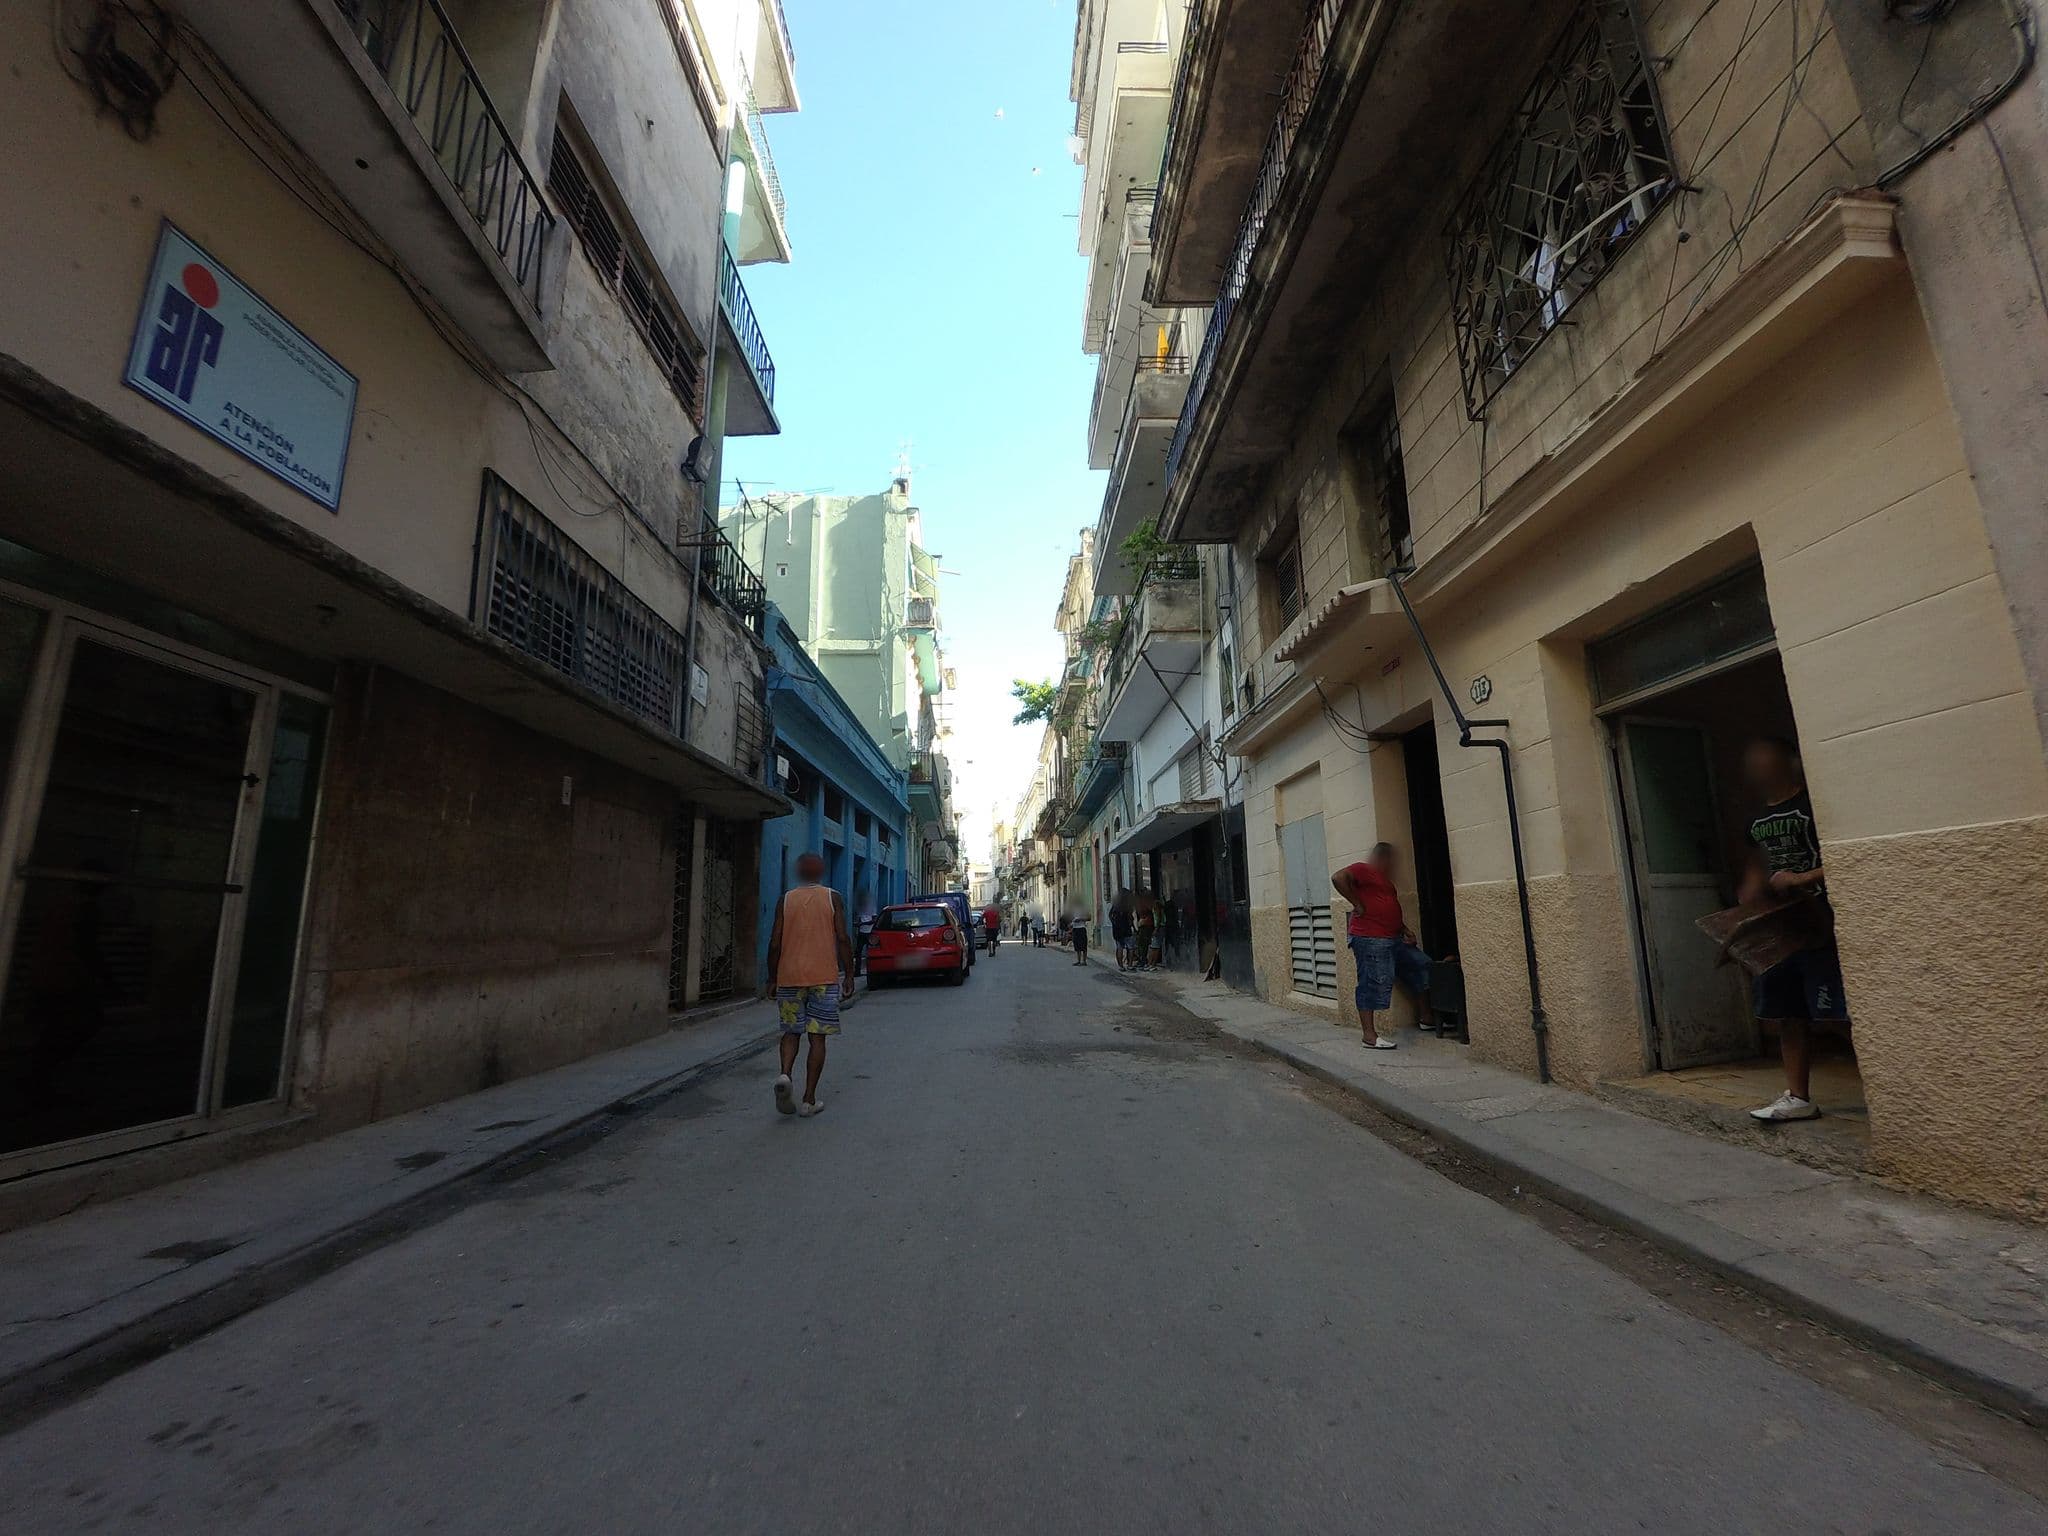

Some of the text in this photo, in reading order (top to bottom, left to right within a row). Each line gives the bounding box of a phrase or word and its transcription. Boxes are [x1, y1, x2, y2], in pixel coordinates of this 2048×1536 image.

[219, 418, 331, 493] A LA POBLACIÓN
[223, 401, 295, 454] ATENCIÓN
